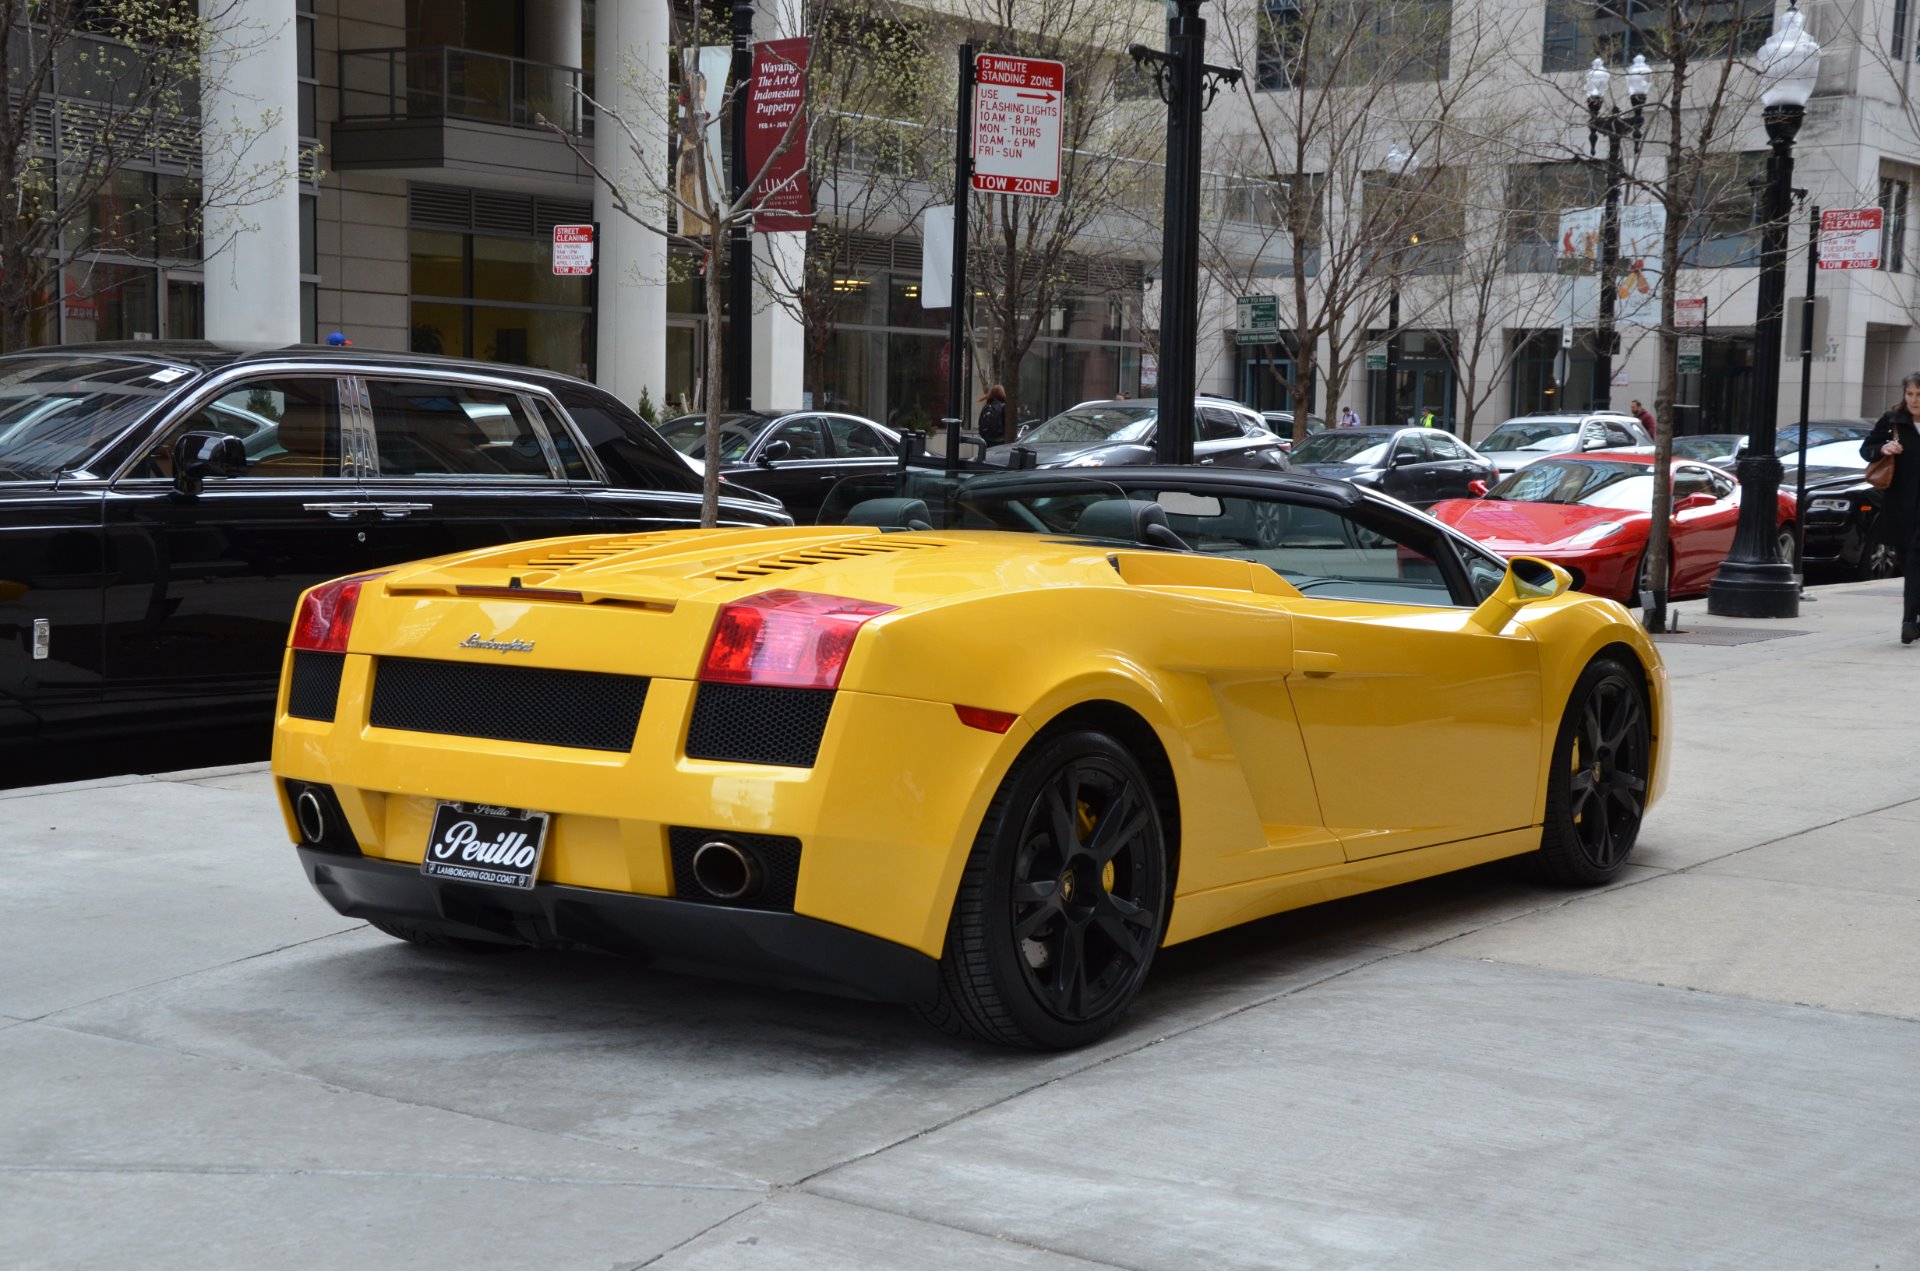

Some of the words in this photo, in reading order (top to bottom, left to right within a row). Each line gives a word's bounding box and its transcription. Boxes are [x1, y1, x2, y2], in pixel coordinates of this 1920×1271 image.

[981, 58, 991, 69] 15
[994, 60, 1028, 73] MINUTE
[757, 75, 773, 87] The
[773, 75, 788, 86] Art
[789, 73, 800, 88] of
[981, 70, 1026, 85] STANDING
[1030, 75, 1054, 88] ZONE
[753, 89, 800, 101] Indonesian
[981, 89, 999, 100] USE
[756, 102, 796, 116] Puppetry
[980, 100, 1025, 114] FLASHING
[1026, 105, 1057, 117] LIGHTS
[1015, 114, 1021, 125] 8
[1024, 115, 1038, 126] PM
[979, 123, 1000, 134] MON
[1011, 125, 1041, 138] THURS
[1013, 137, 1020, 148] 6
[1022, 138, 1036, 149] PM
[978, 145, 994, 156] FRI
[1003, 147, 1022, 159] SUN
[758, 178, 799, 193] LUMA
[977, 175, 1008, 190] TOW
[1014, 178, 1052, 194] ZONE
[1825, 211, 1862, 220] STREET
[557, 227, 580, 235] STREET
[1824, 219, 1875, 230] CLEANING
[556, 234, 588, 242] CLEANING
[1852, 251, 1866, 259] OCT
[1822, 260, 1843, 269] TOW
[1847, 260, 1873, 268] ZONE
[458, 632, 536, 654] Lamborghini
[473, 804, 511, 817] Perillo
[434, 820, 536, 868] Perillo
[436, 865, 479, 880] LAMBORGHINI
[478, 871, 496, 882] GOLD
[496, 874, 517, 885] COAST
